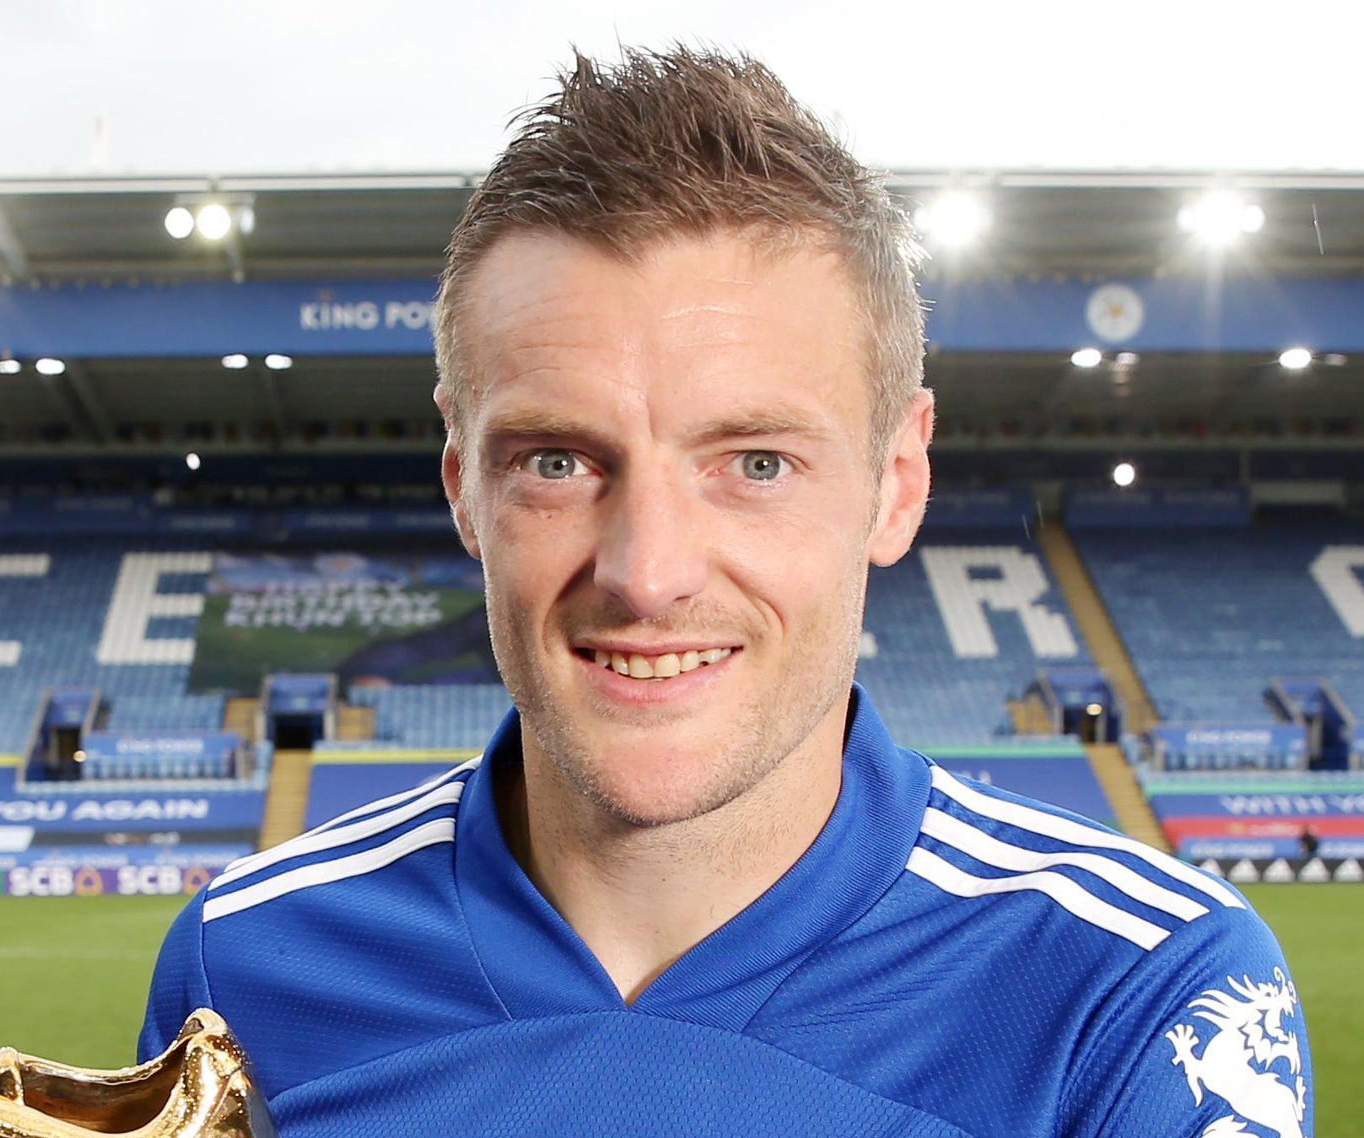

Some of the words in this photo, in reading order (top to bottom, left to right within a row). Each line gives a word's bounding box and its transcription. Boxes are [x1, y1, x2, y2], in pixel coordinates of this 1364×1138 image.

[300, 301, 379, 330] KING
[71, 799, 210, 821] AGAIN
[1221, 795, 1329, 815] WITH
[9, 866, 74, 896] SCB
[117, 866, 182, 896] SCB
